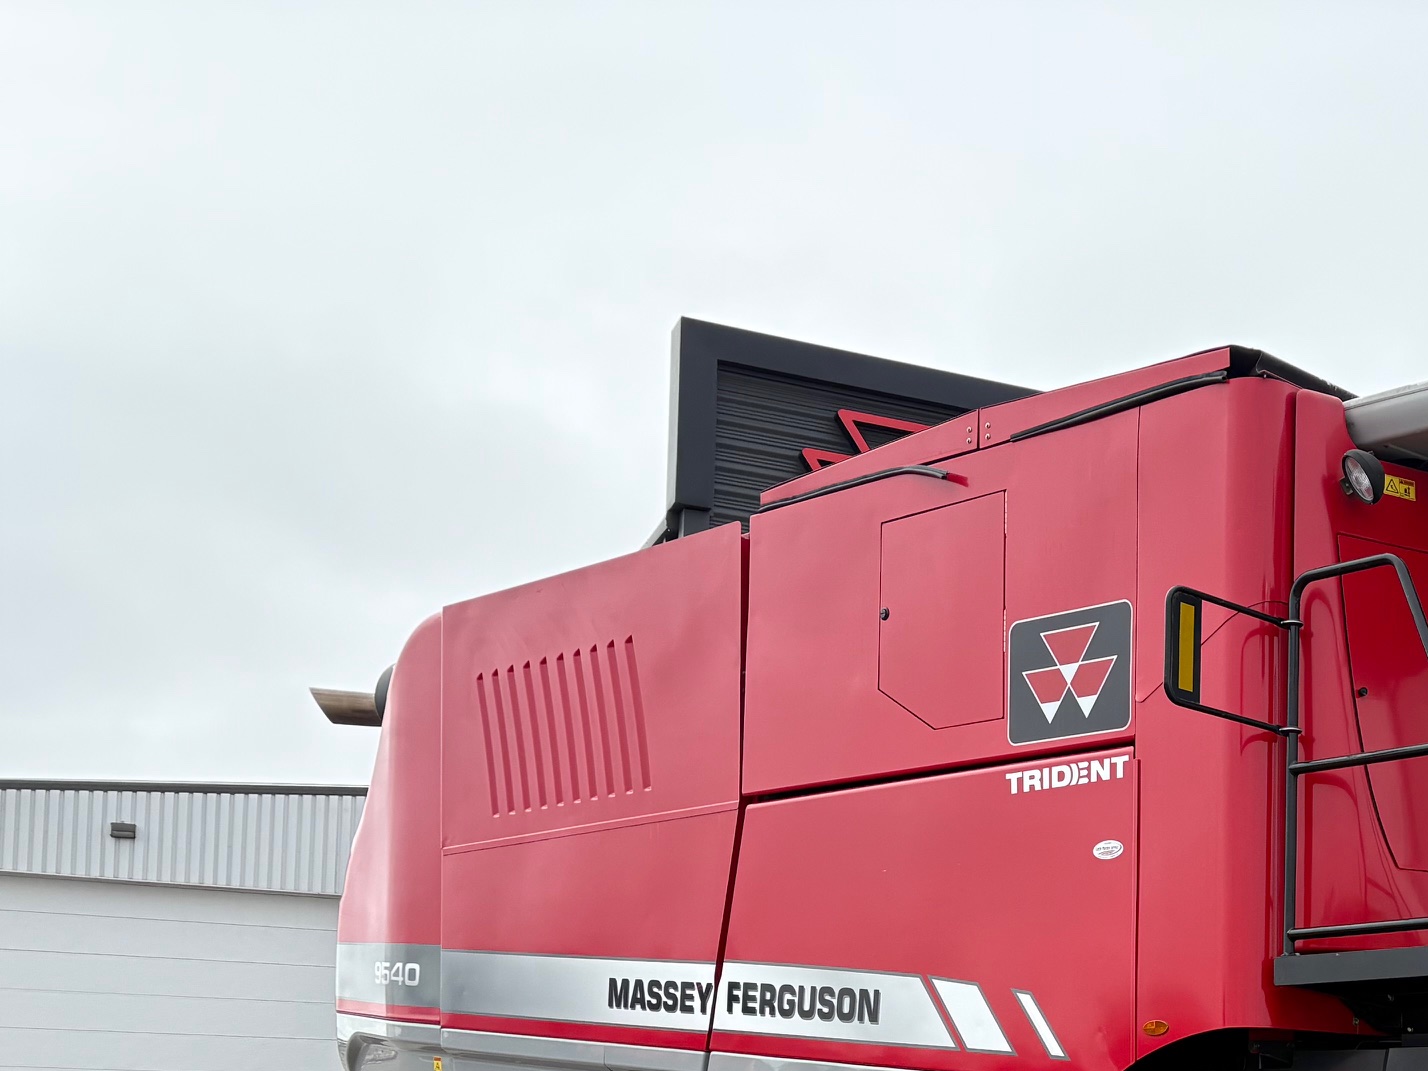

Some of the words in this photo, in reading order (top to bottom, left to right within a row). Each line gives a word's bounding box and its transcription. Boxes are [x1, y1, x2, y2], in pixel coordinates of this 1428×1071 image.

[1005, 755, 1129, 794] TRIDENT
[375, 961, 420, 986] 9540
[608, 977, 713, 1015] MASSEY
[726, 981, 881, 1024] FERGUSON
